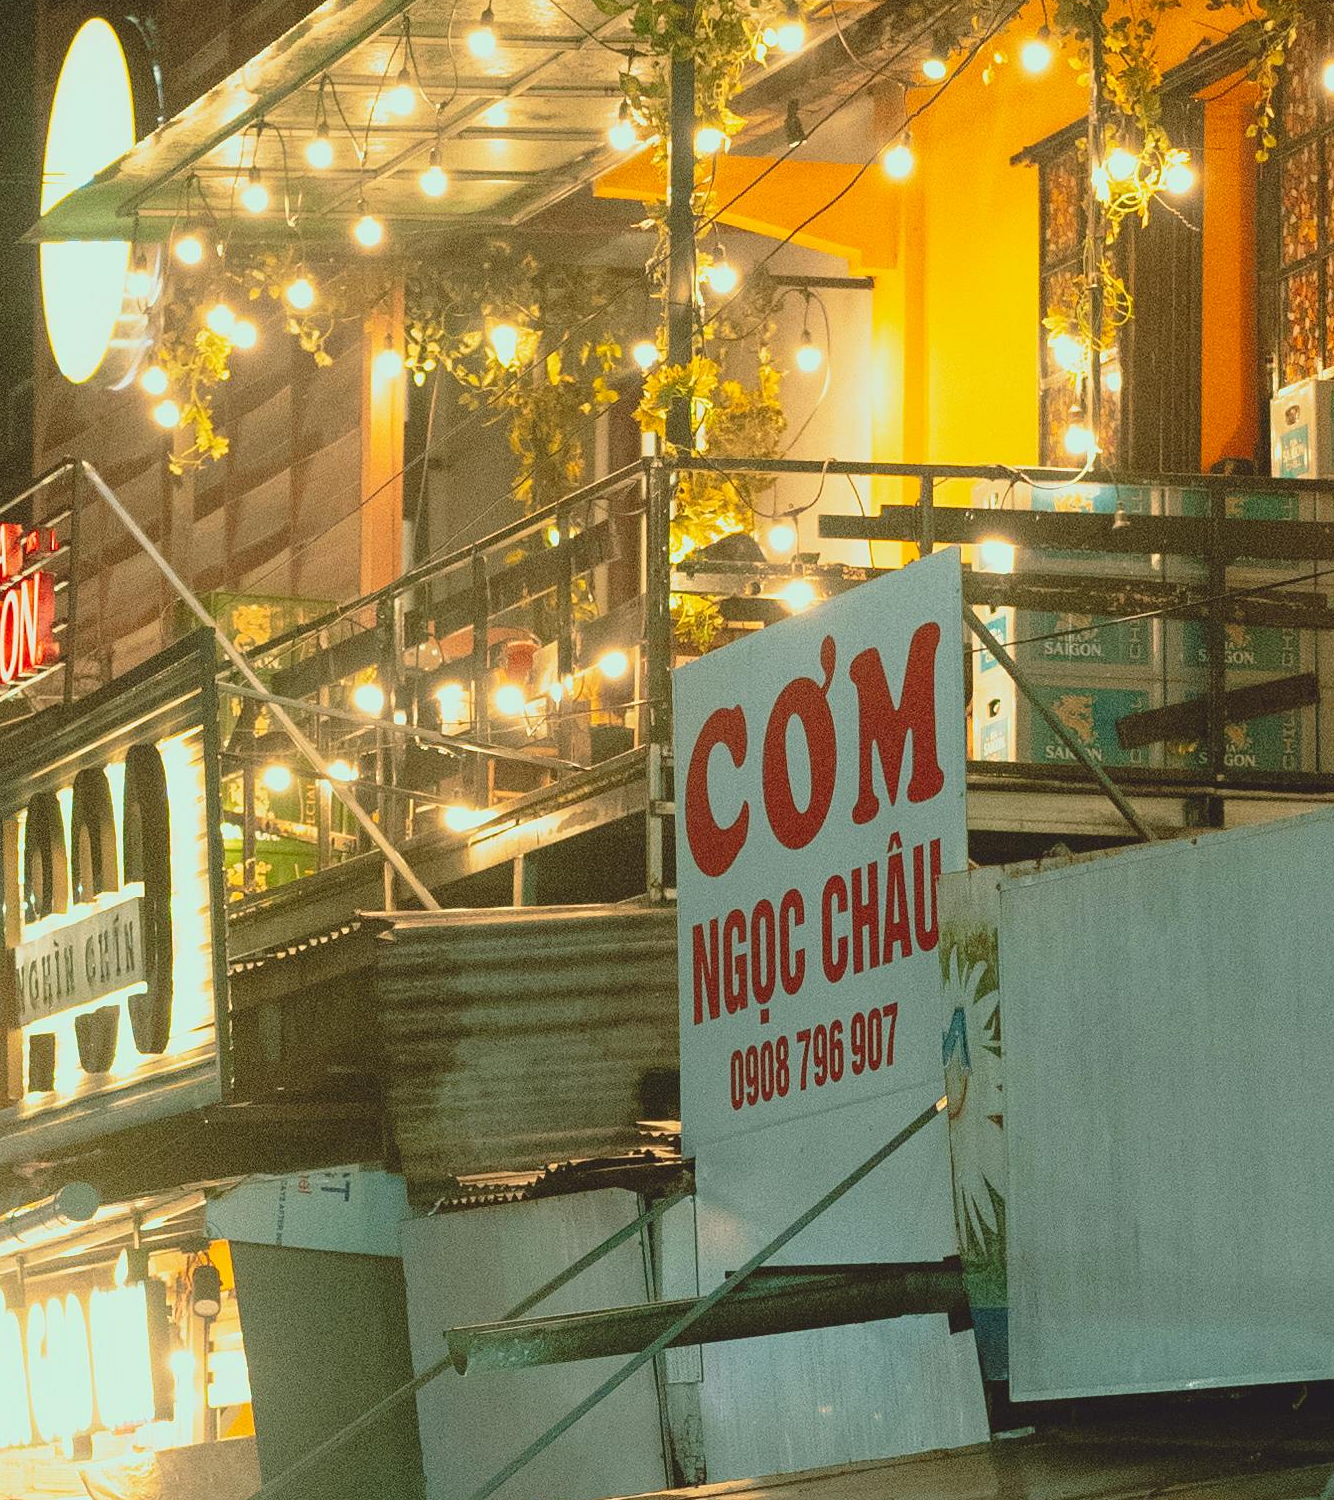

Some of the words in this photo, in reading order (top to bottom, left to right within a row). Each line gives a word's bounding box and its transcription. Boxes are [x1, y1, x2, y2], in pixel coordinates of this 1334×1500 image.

[1044, 641, 1102, 657] SAIGON
[684, 621, 946, 877] CƠM
[692, 888, 806, 1026] NGỌC
[821, 832, 942, 983] CHÂU
[730, 1027, 790, 1111] 0908
[796, 1019, 844, 1091] 796
[851, 1001, 899, 1073] 907
